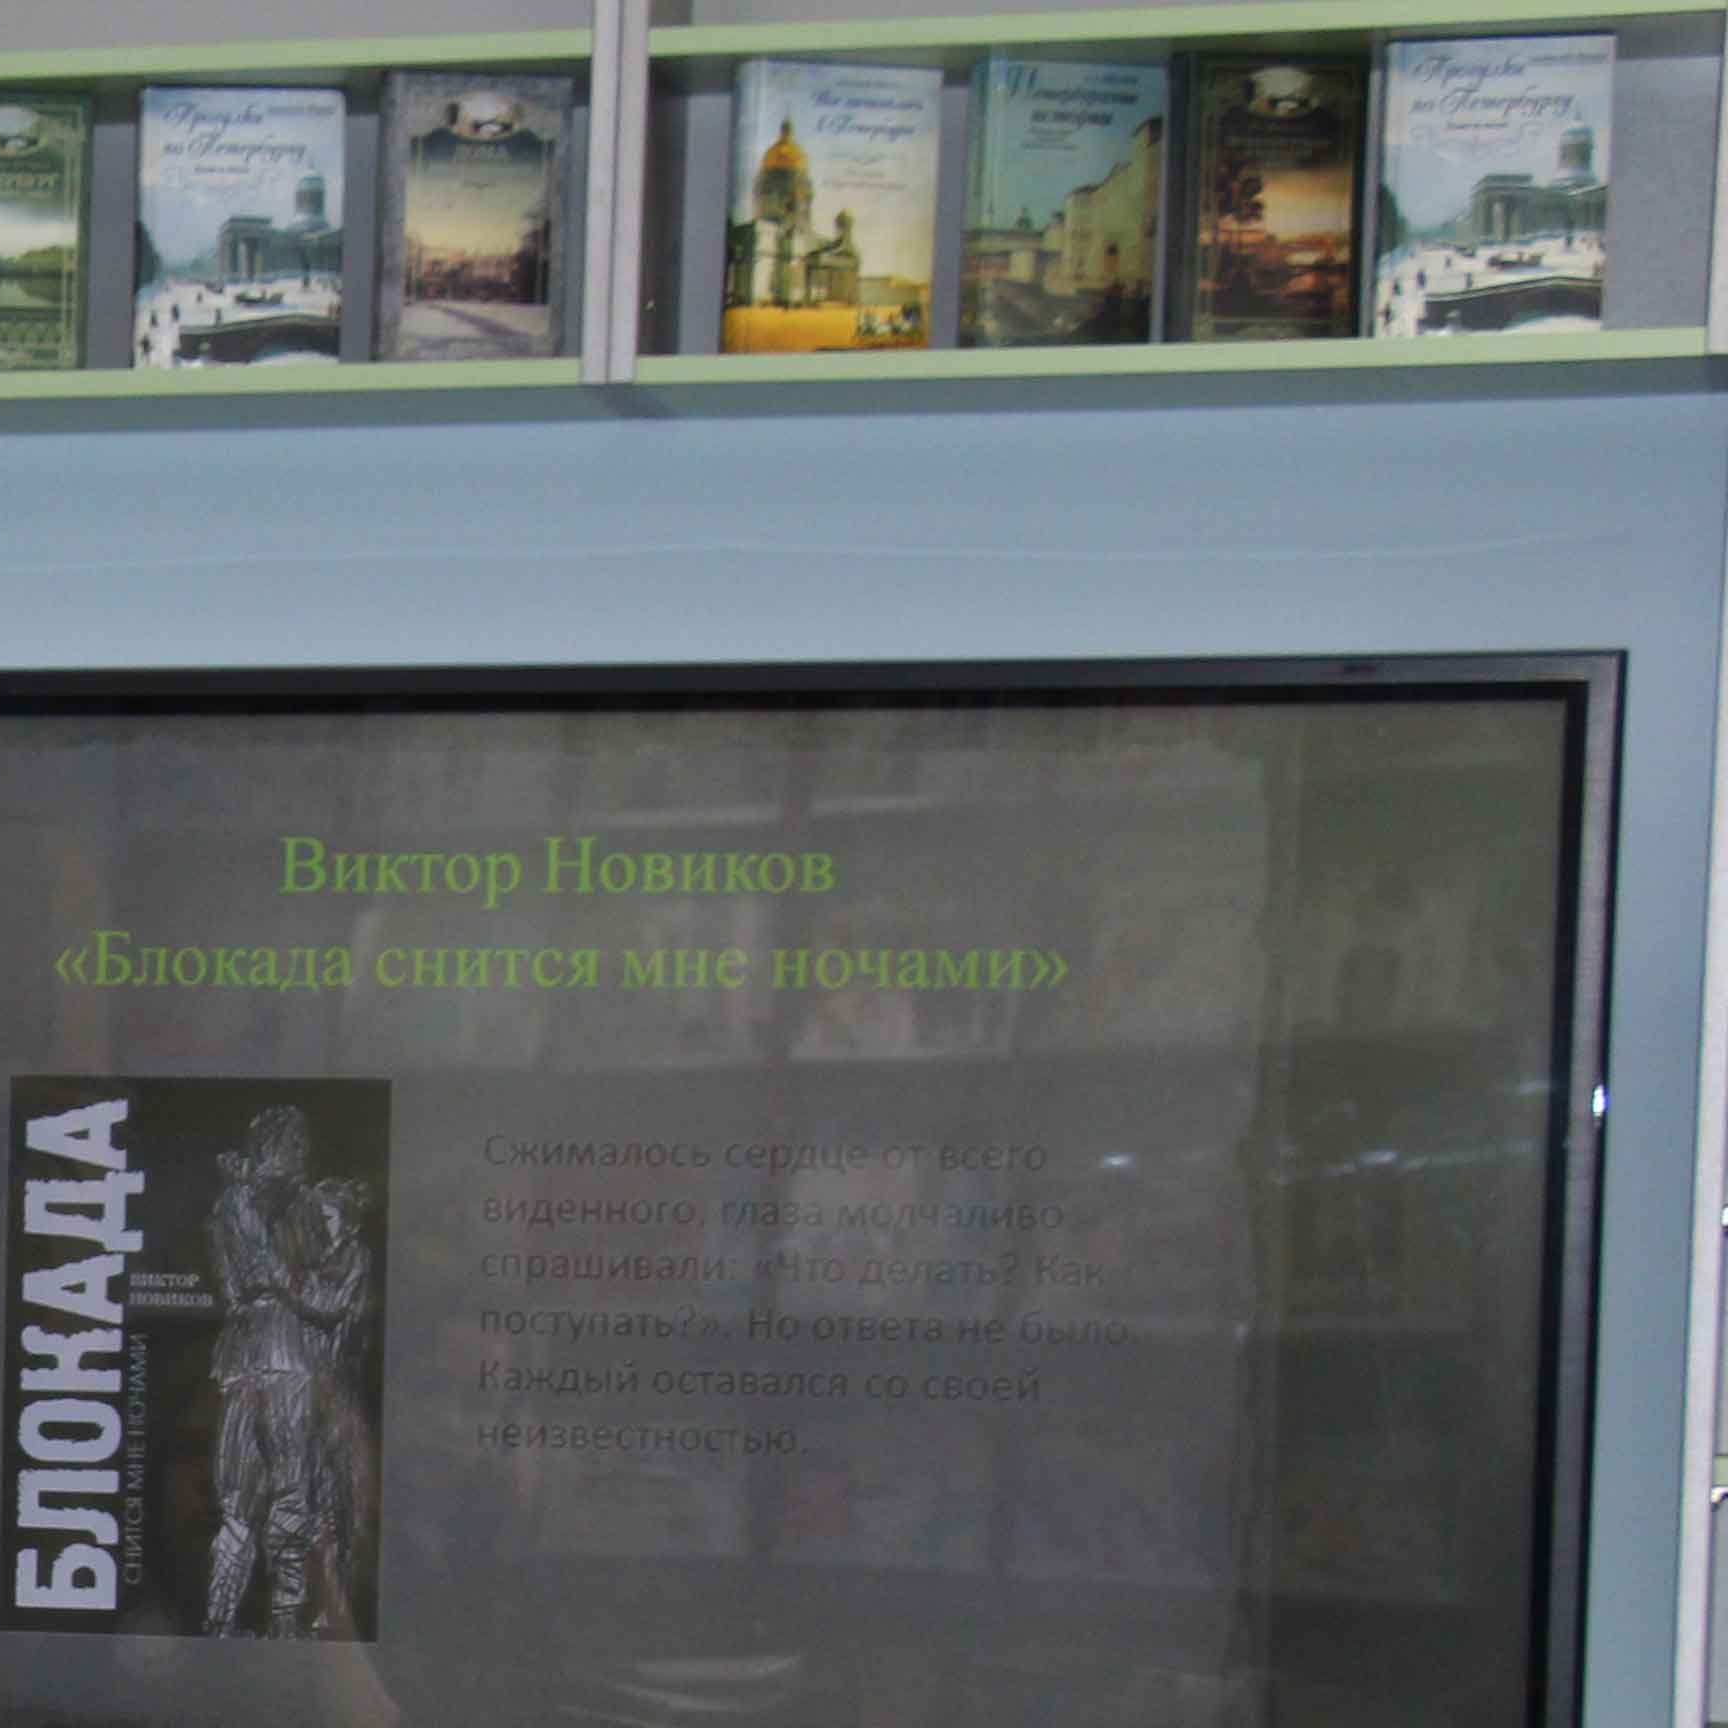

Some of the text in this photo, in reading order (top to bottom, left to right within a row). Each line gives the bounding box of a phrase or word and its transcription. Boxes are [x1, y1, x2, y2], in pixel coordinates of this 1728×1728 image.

[280, 835, 835, 910] Виктор Новиков
[54, 928, 1069, 992] «Блокада снится мне ночами»
[484, 1134, 1046, 1176] Сжималось сердце от всего
[721, 1201, 823, 1228] глаза
[836, 1203, 1065, 1231] молчаливо
[755, 1252, 845, 1283] «Что
[858, 1251, 1021, 1289] делать?
[1035, 1254, 1105, 1288] Как
[749, 1307, 799, 1341] Но
[812, 1314, 944, 1343] ответа
[955, 1317, 1006, 1344] не
[479, 1358, 1041, 1400] Каждый оставался со своей
[476, 1421, 809, 1455] неизвестностью.
